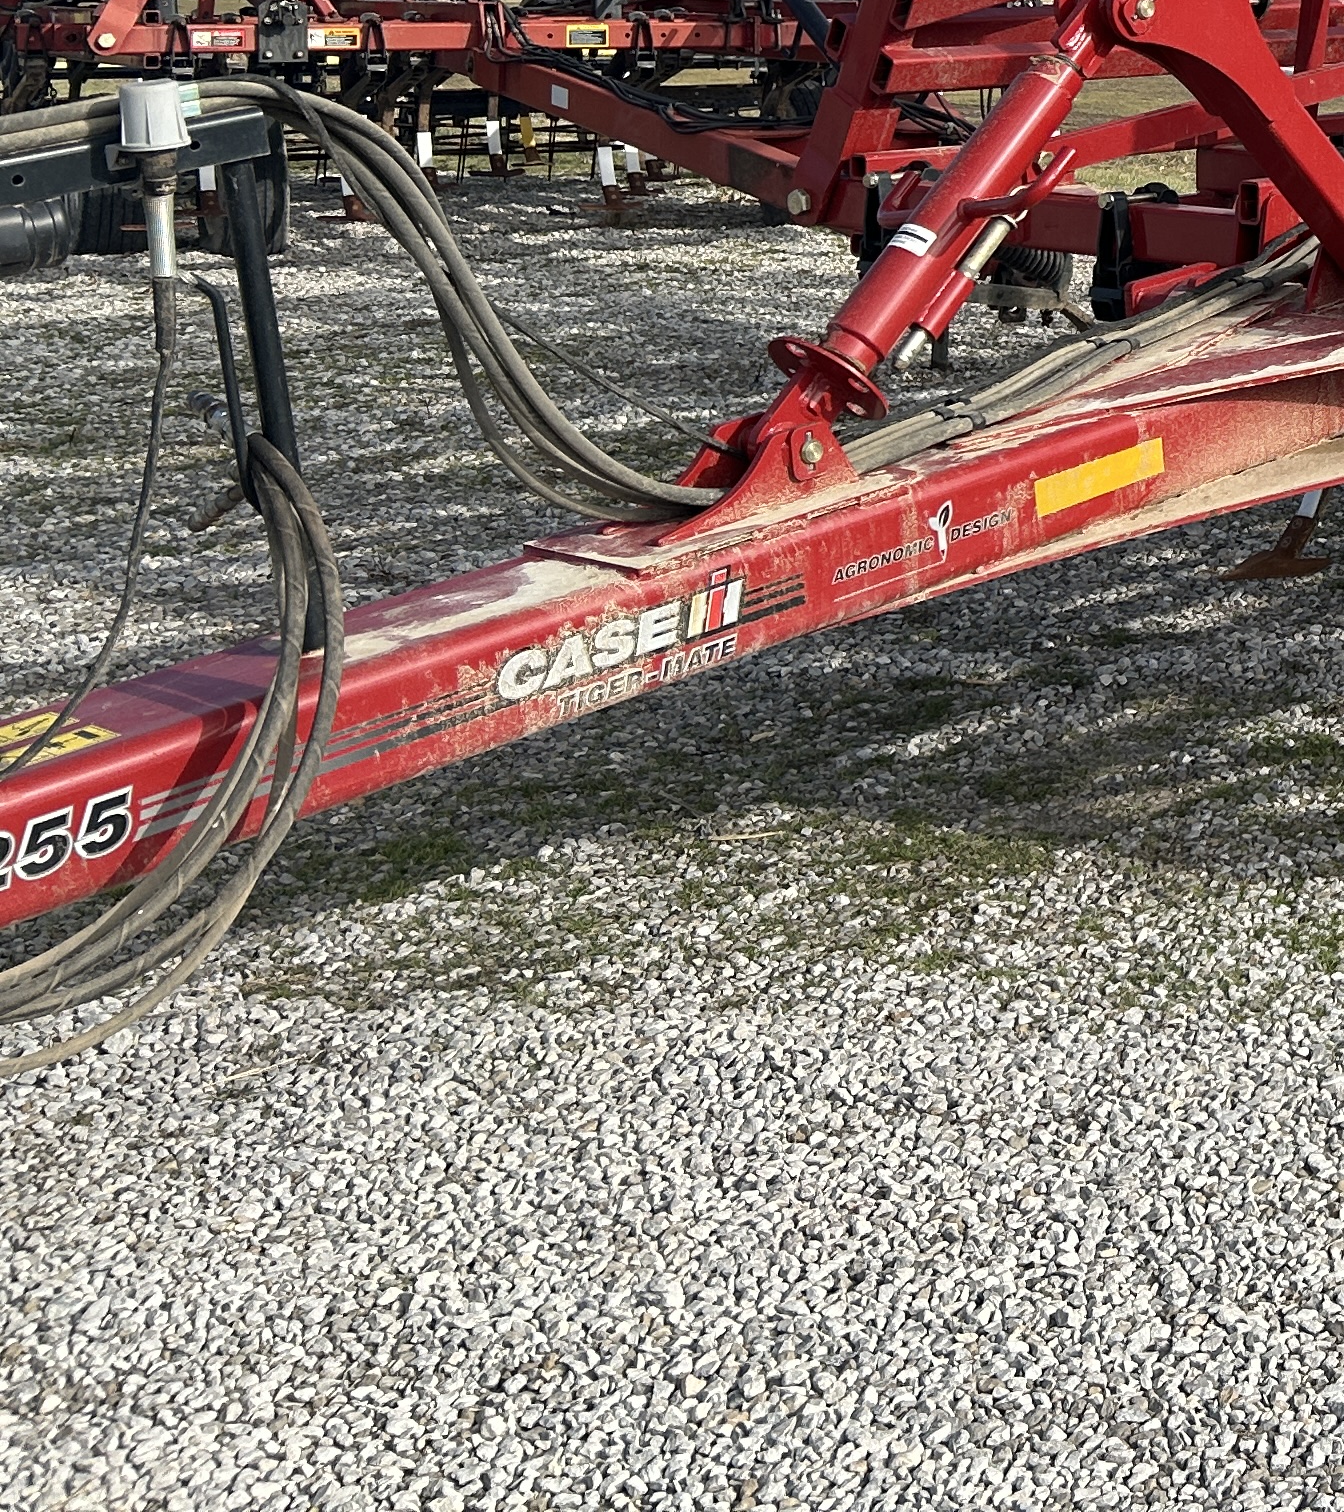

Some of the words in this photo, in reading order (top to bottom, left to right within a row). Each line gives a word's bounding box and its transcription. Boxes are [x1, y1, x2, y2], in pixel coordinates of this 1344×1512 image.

[832, 536, 935, 585] AGRONOMIC
[949, 507, 1013, 543] DESIGN
[497, 599, 683, 701] CASE
[557, 633, 738, 719] TIGER-MATE
[0, 784, 134, 892] 55
